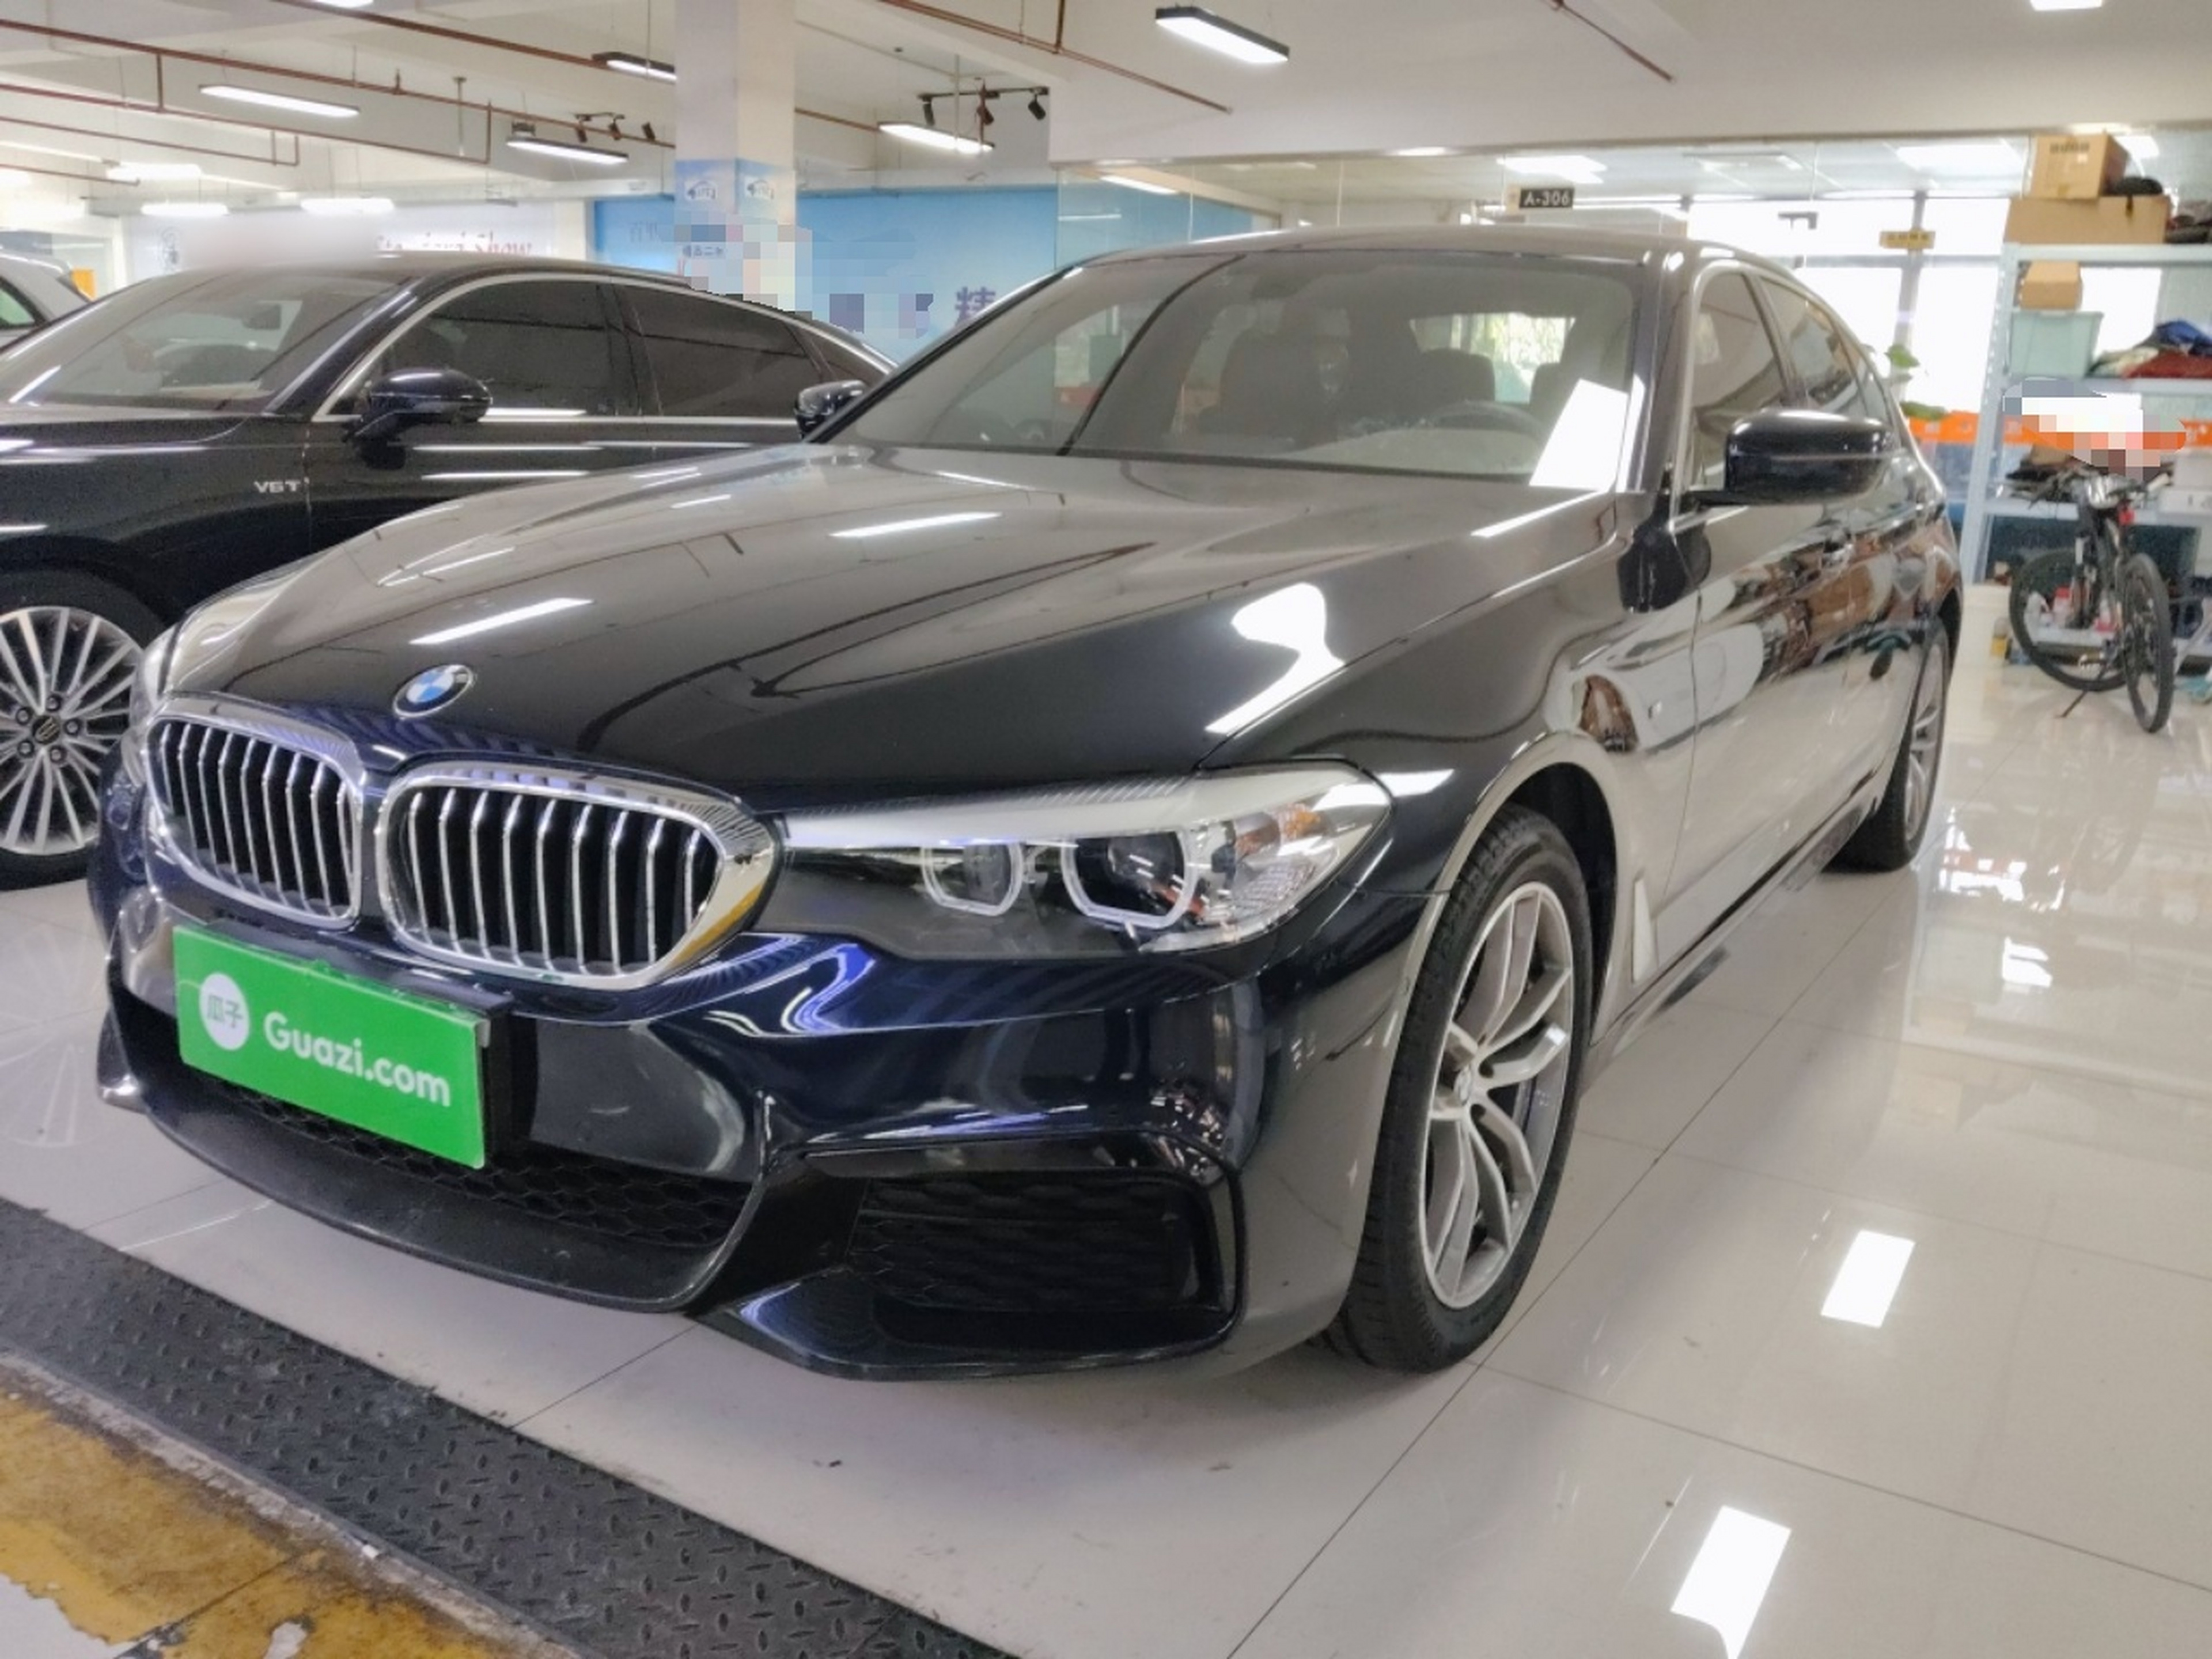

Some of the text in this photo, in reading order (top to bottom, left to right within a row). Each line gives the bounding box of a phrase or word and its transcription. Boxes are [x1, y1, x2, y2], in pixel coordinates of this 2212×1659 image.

[1524, 190, 1570, 206] A-306
[254, 480, 301, 493] V6T
[207, 994, 244, 1029] 瓜子
[264, 1010, 451, 1108] Guazi.com
